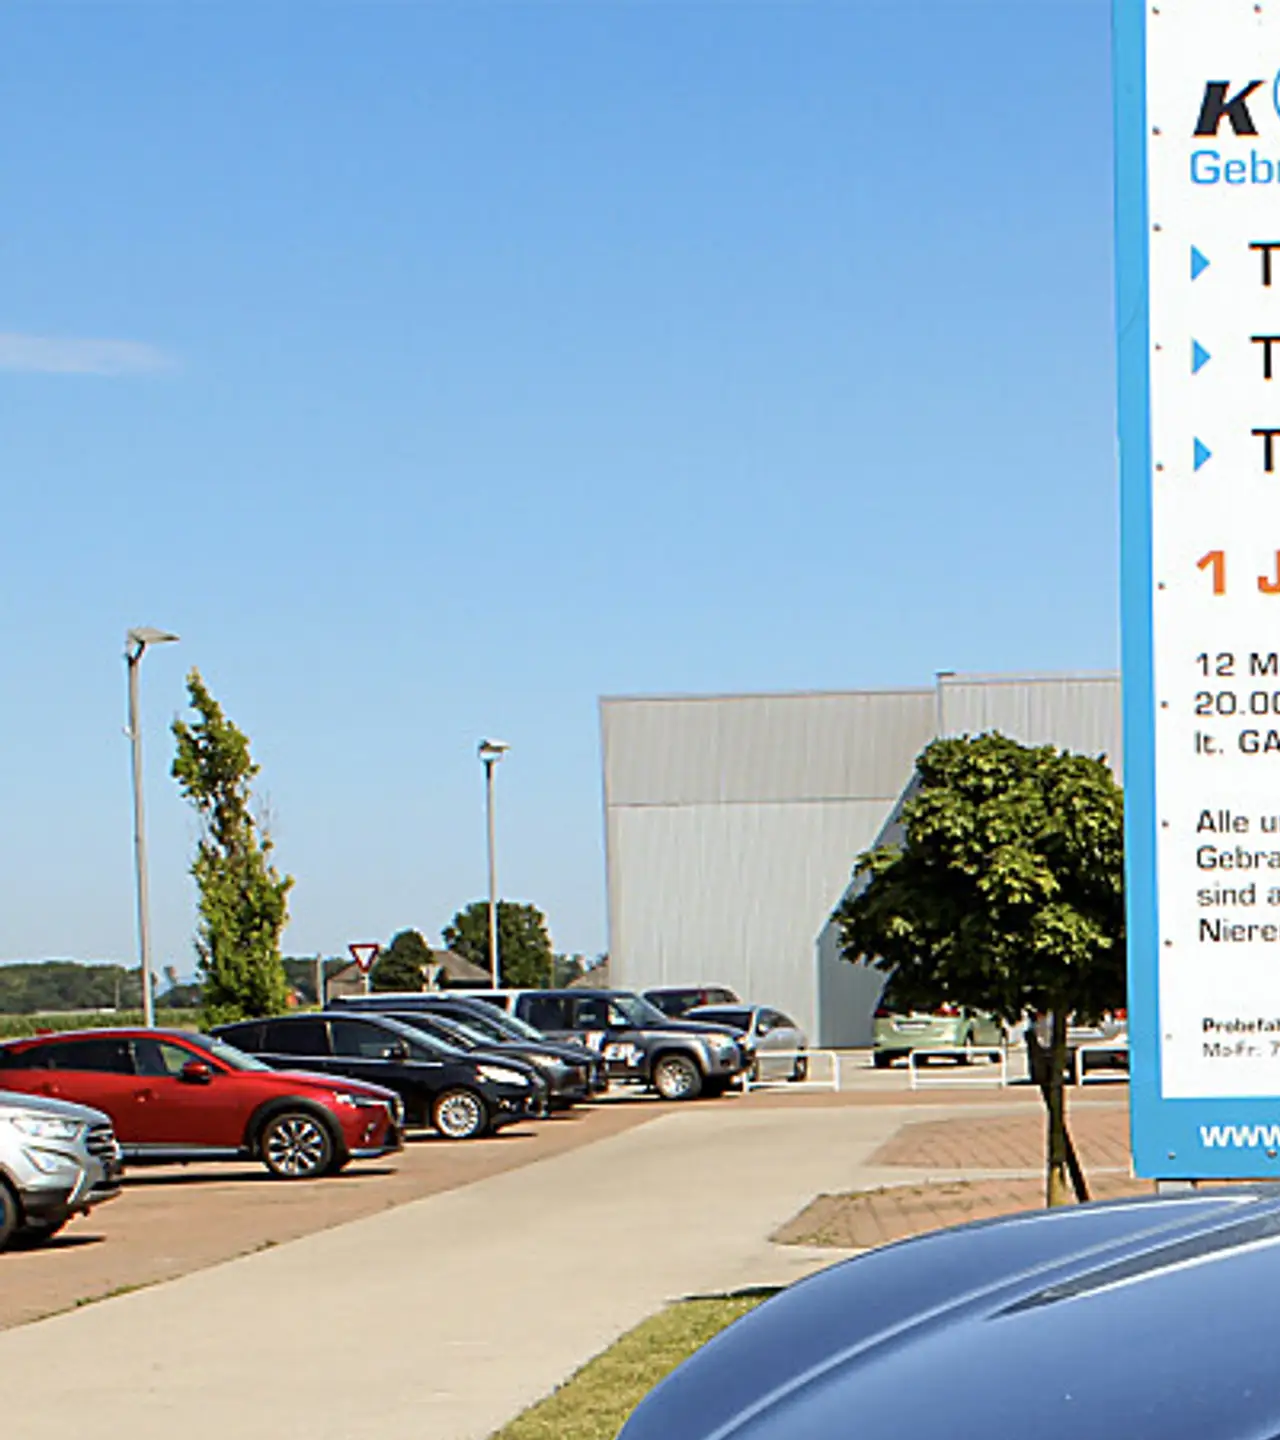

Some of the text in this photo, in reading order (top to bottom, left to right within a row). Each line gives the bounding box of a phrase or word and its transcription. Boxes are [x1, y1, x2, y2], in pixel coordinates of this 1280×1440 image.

[1197, 550, 1226, 596] 1
[1197, 652, 1235, 677] 12
[1196, 809, 1249, 833] Alle
[1197, 880, 1256, 907] sind
